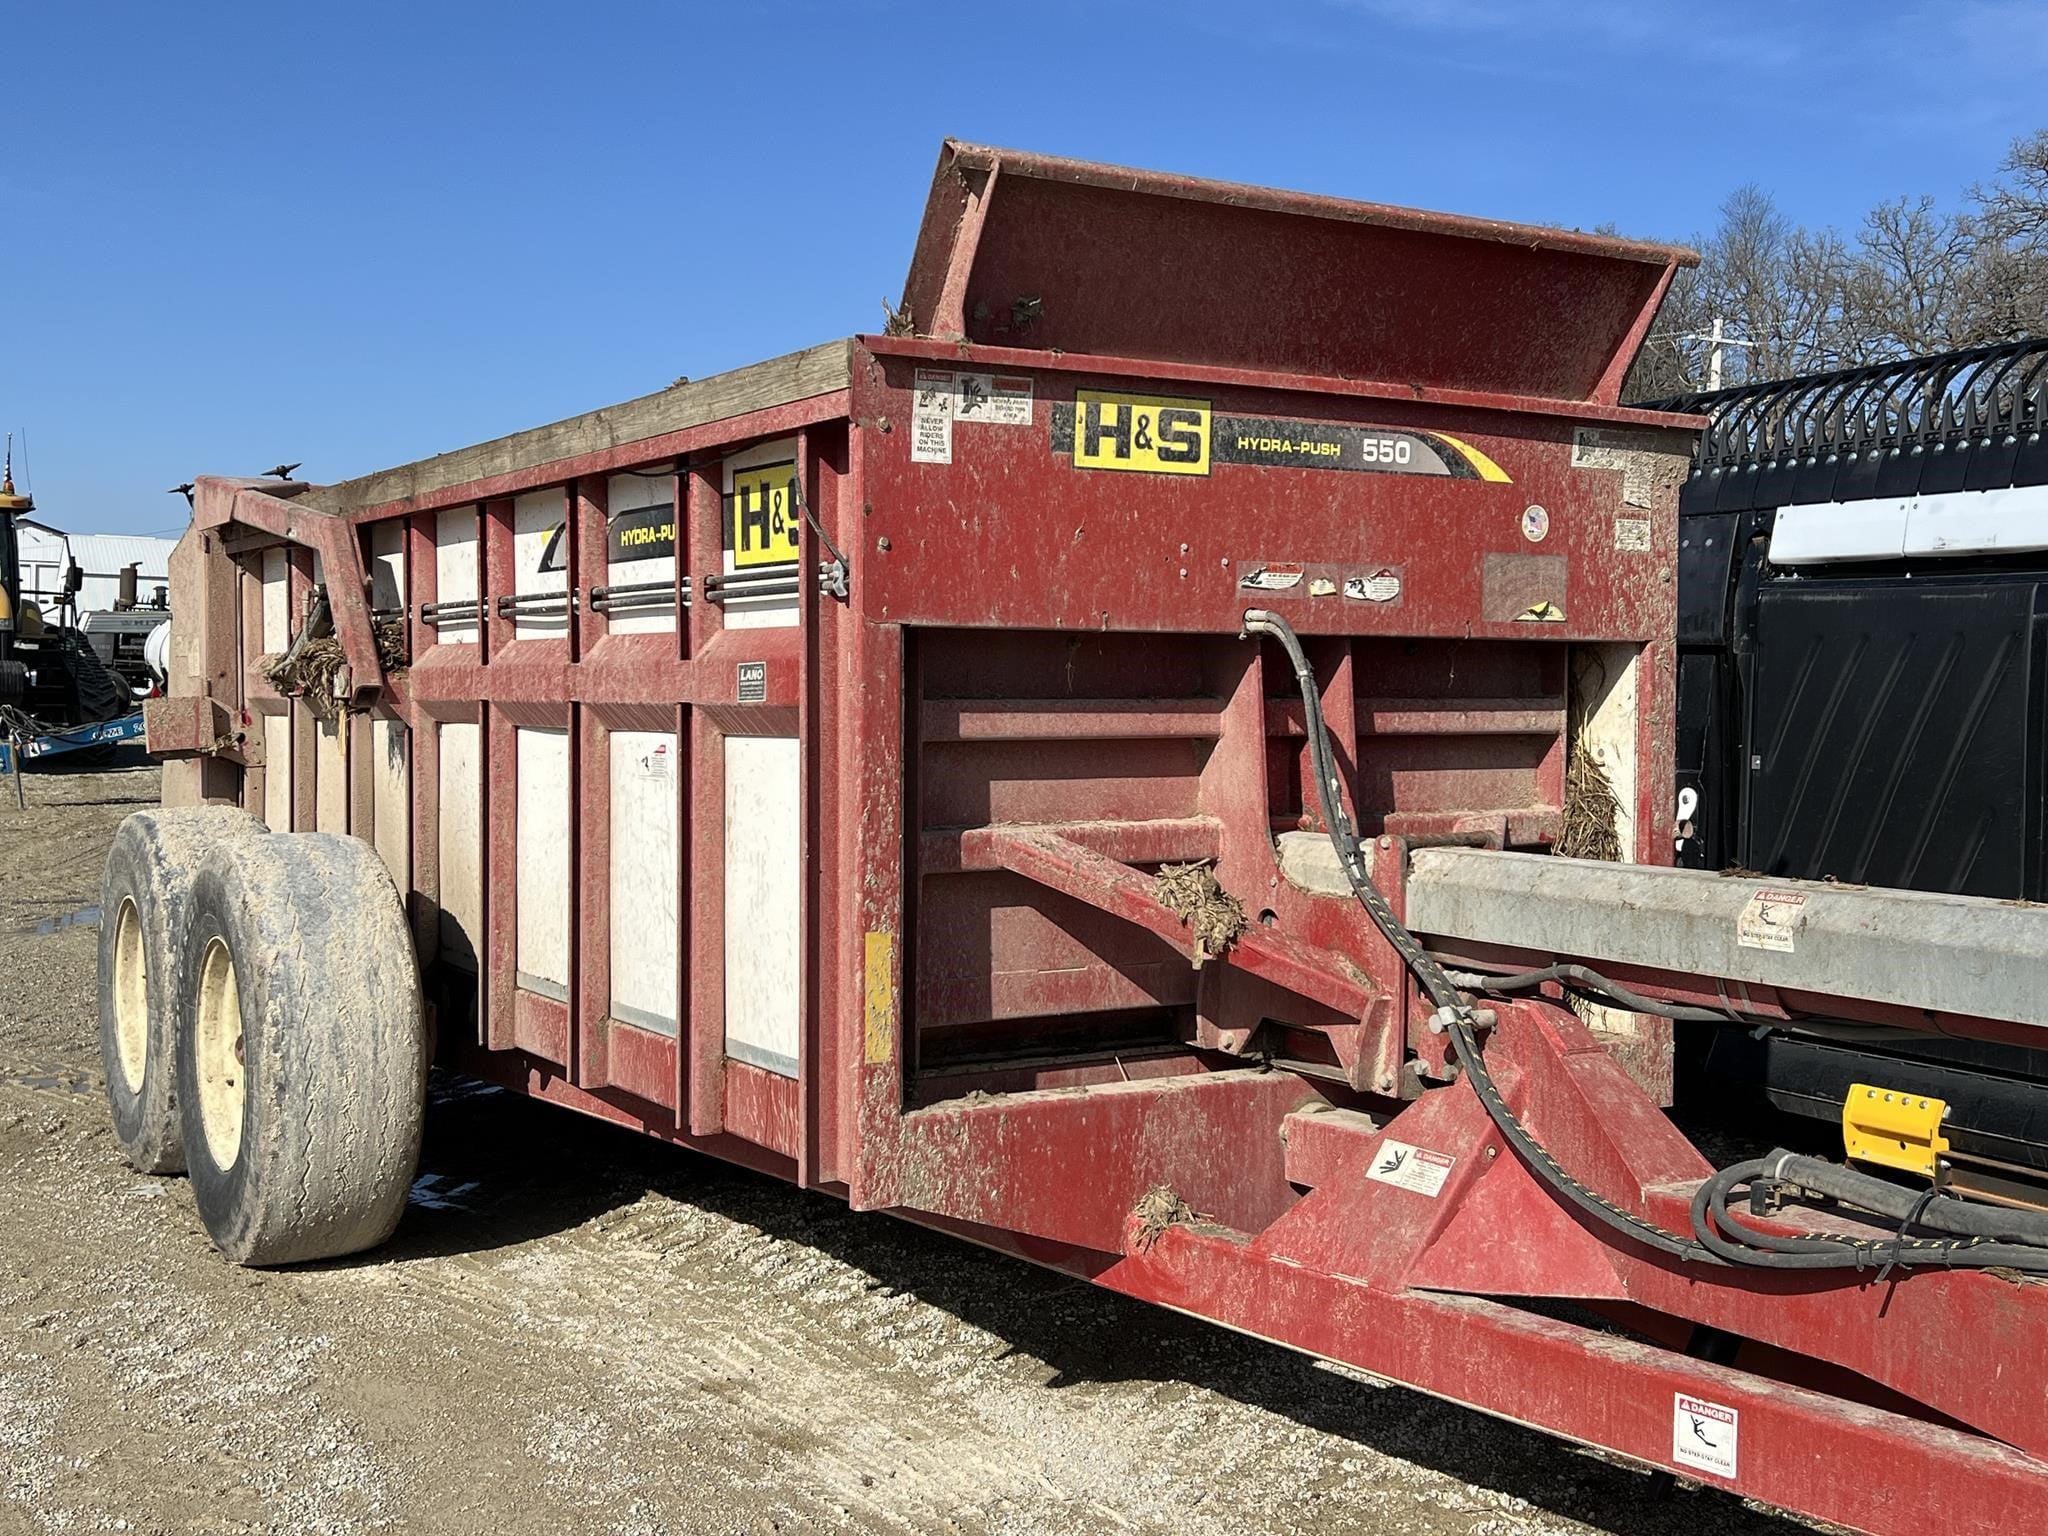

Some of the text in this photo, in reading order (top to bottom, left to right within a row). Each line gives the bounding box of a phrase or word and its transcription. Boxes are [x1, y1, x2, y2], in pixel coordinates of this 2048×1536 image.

[921, 417, 944, 425] NEVER
[920, 424, 944, 432] ALLOW
[1083, 401, 1411, 464] H&S HYDRA-PUSH 550
[919, 431, 944, 440] RIDERS
[918, 438, 945, 447] ON THIS
[916, 446, 947, 455] MACHINE
[620, 523, 677, 547] HYDRA-PU
[740, 668, 764, 681] LANO
[1766, 893, 1805, 904] DANGER
[1690, 1403, 1732, 1423] DANGER
[1714, 1457, 1731, 1468] CLEAR
